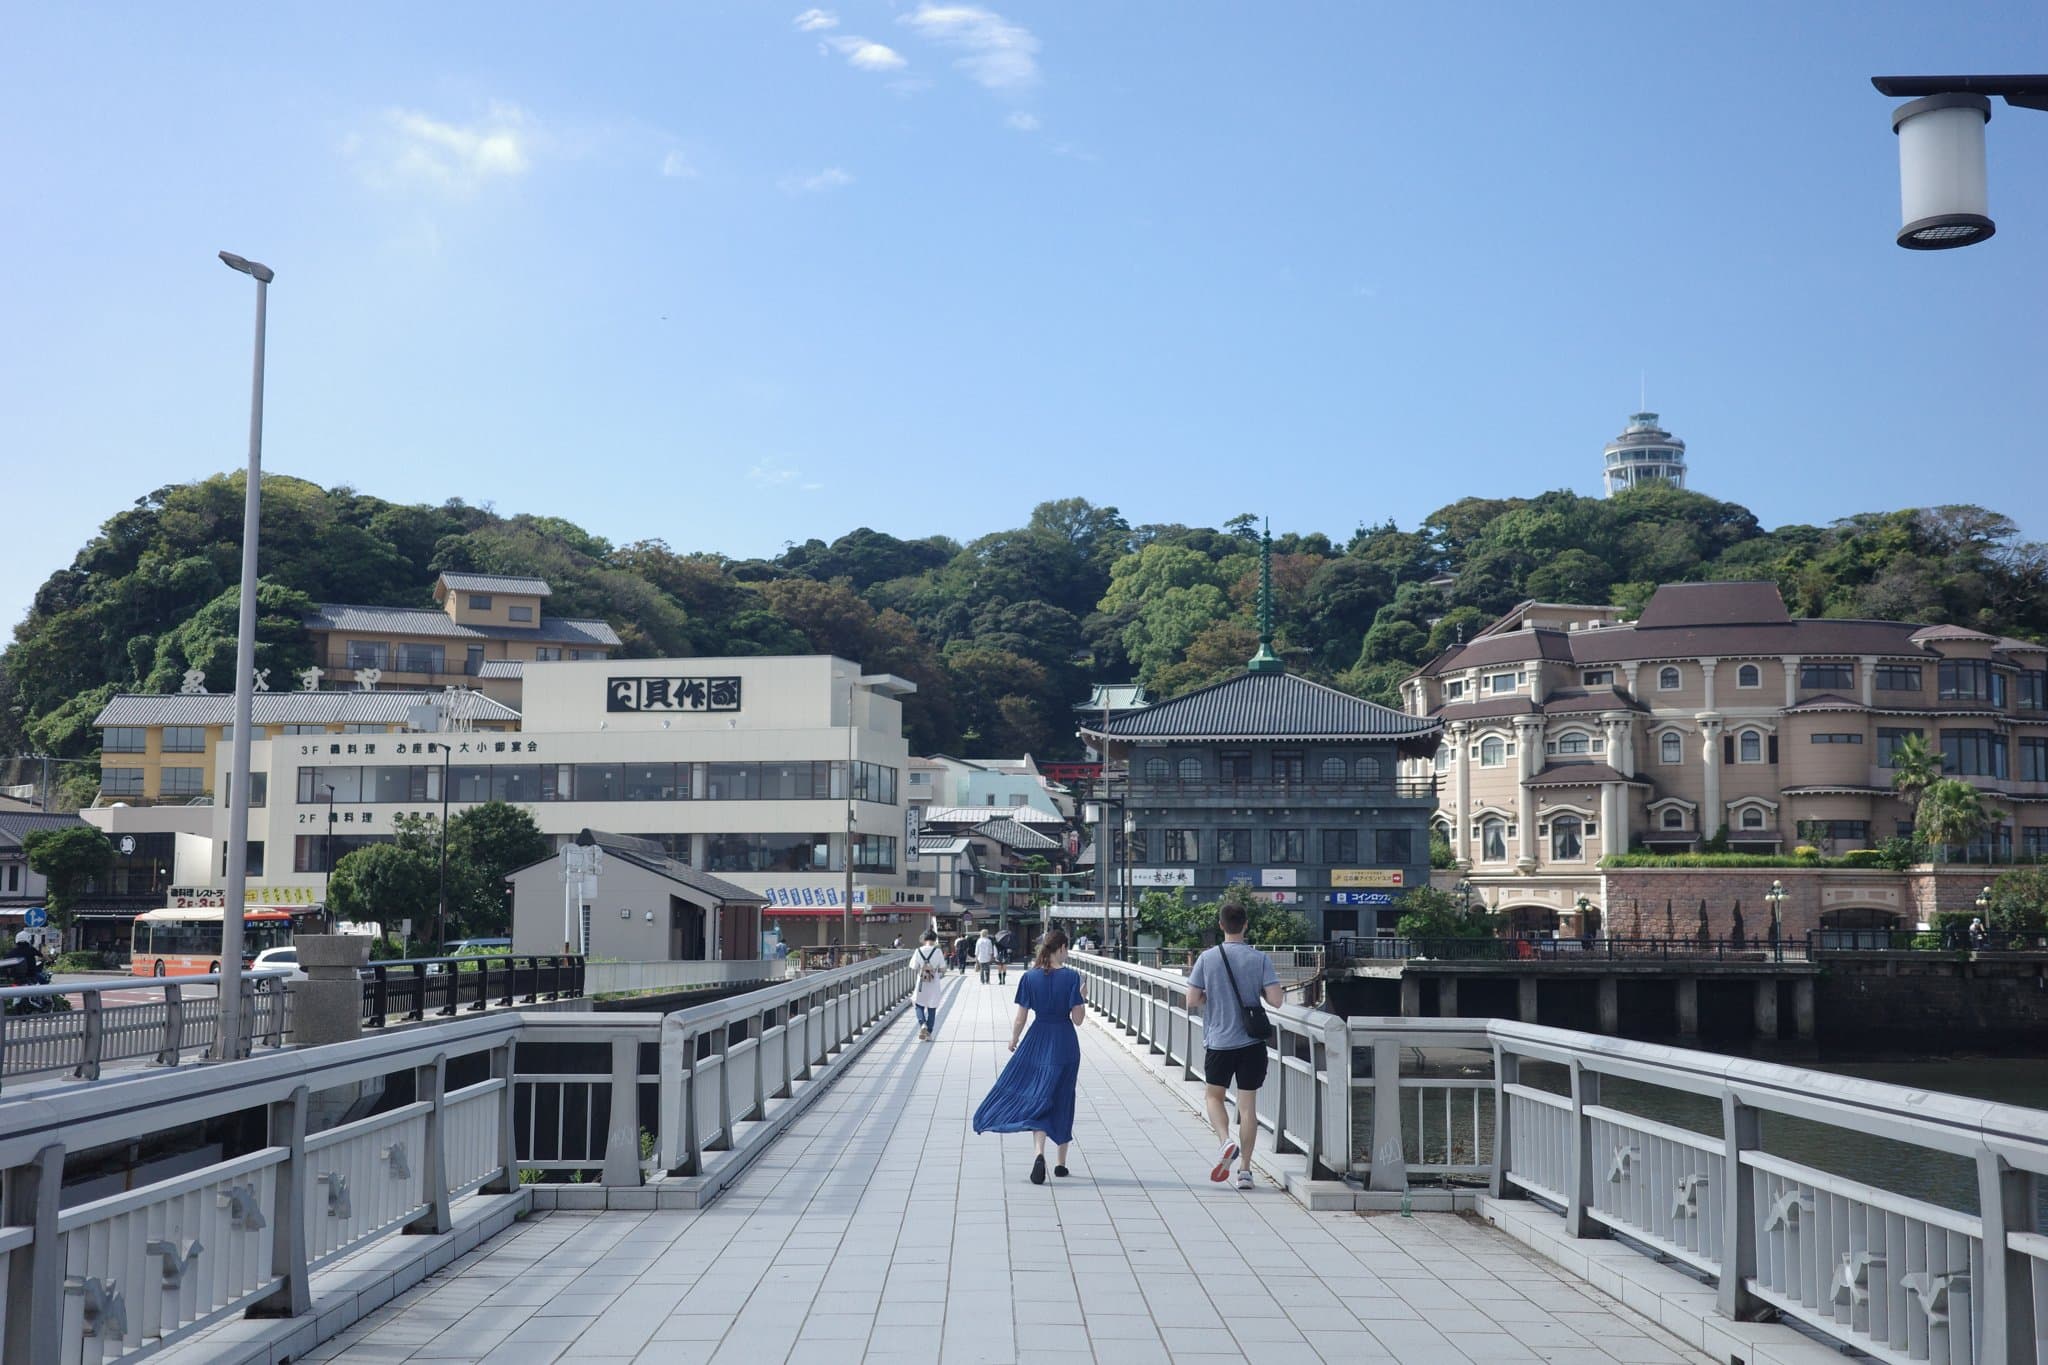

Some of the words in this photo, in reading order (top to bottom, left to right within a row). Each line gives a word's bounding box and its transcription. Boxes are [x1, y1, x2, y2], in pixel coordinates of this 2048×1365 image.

[301, 745, 319, 755] 3F
[299, 814, 316, 824] 2F
[196, 888, 226, 898] レストラ
